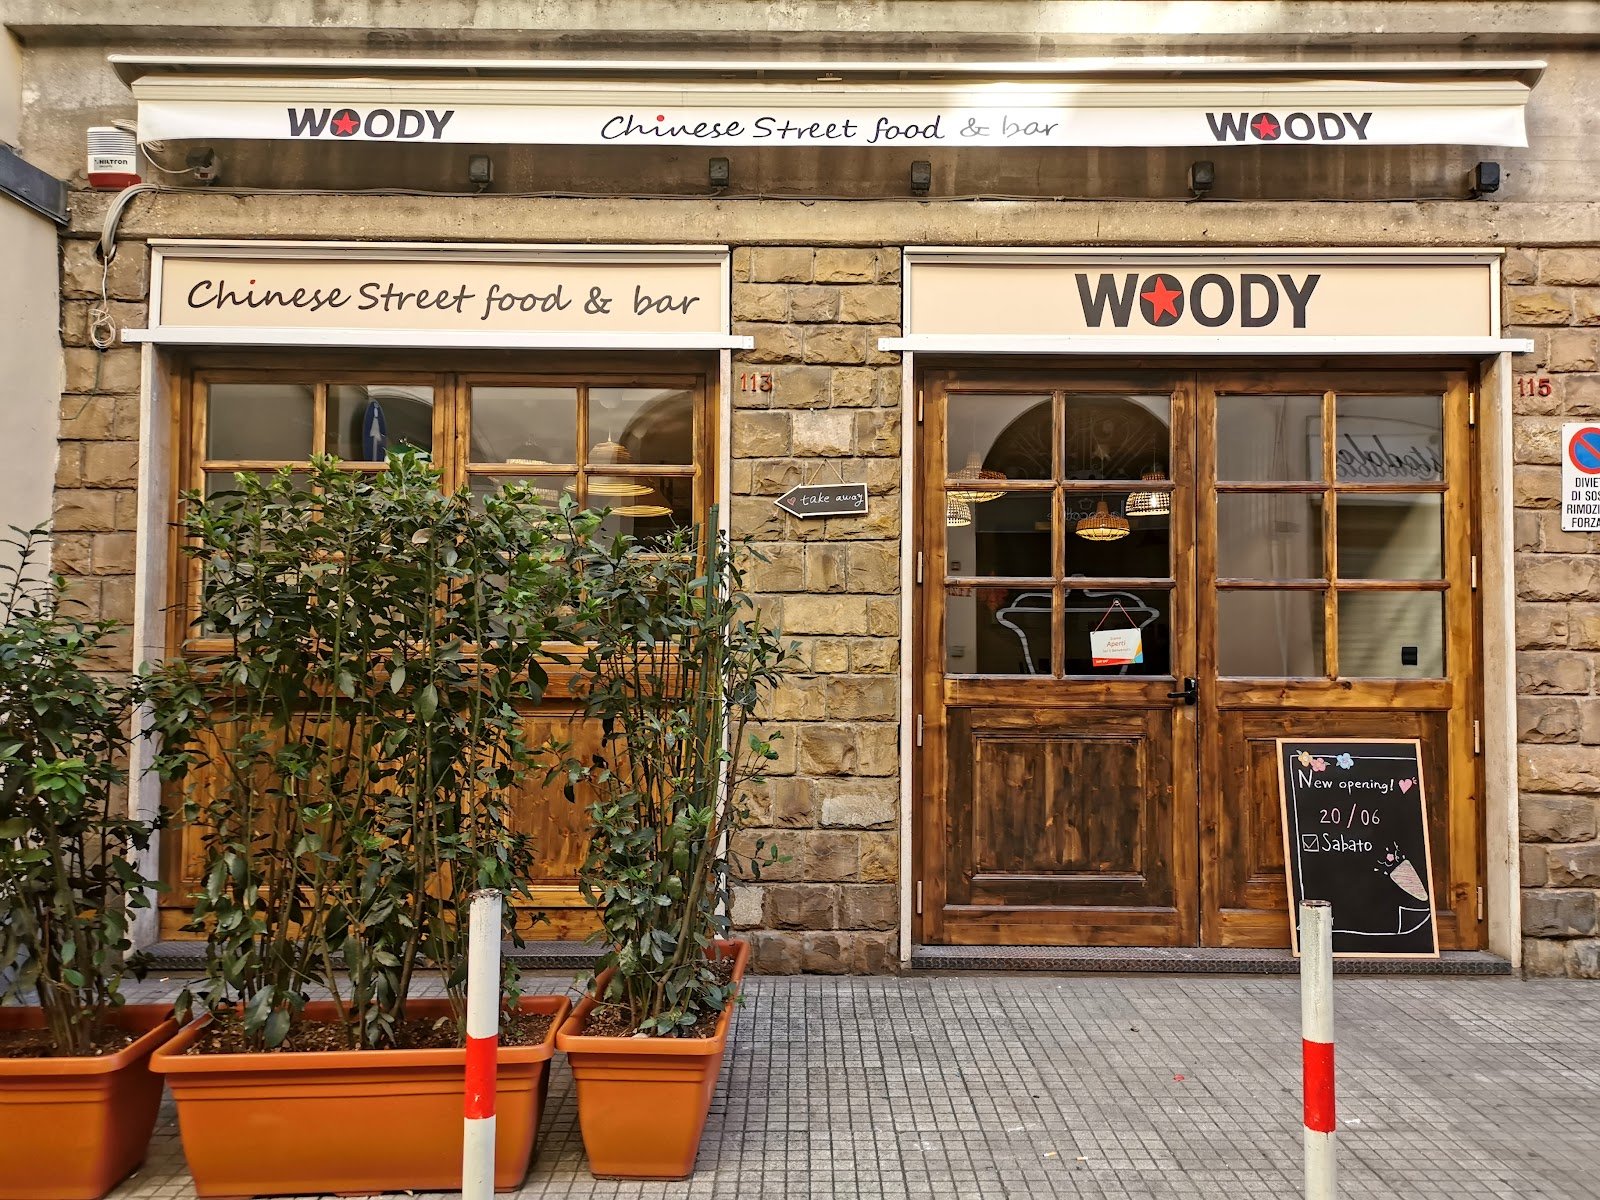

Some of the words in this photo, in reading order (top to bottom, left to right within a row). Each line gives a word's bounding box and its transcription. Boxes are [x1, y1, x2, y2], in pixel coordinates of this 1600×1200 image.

[287, 108, 455, 139] WOODY
[601, 114, 745, 140] Chinese
[753, 116, 858, 139] Street
[867, 115, 945, 143] food
[960, 117, 990, 137] &
[1002, 115, 1059, 138] bar
[1205, 112, 1373, 141] WOODY
[188, 279, 351, 312] Chinese
[358, 283, 475, 313] Street
[481, 284, 572, 320] food
[584, 286, 612, 314] &
[634, 285, 700, 315] bar
[1075, 273, 1321, 328] WOODY
[740, 373, 773, 393] 113
[1517, 378, 1552, 397] 115
[1575, 477, 1600, 488] DIVIE
[800, 492, 830, 506] take
[836, 493, 864, 507] away
[1571, 490, 1581, 501] DI
[1298, 769, 1333, 789] New
[1339, 778, 1394, 795] opening!
[1321, 832, 1373, 853] Sabato
